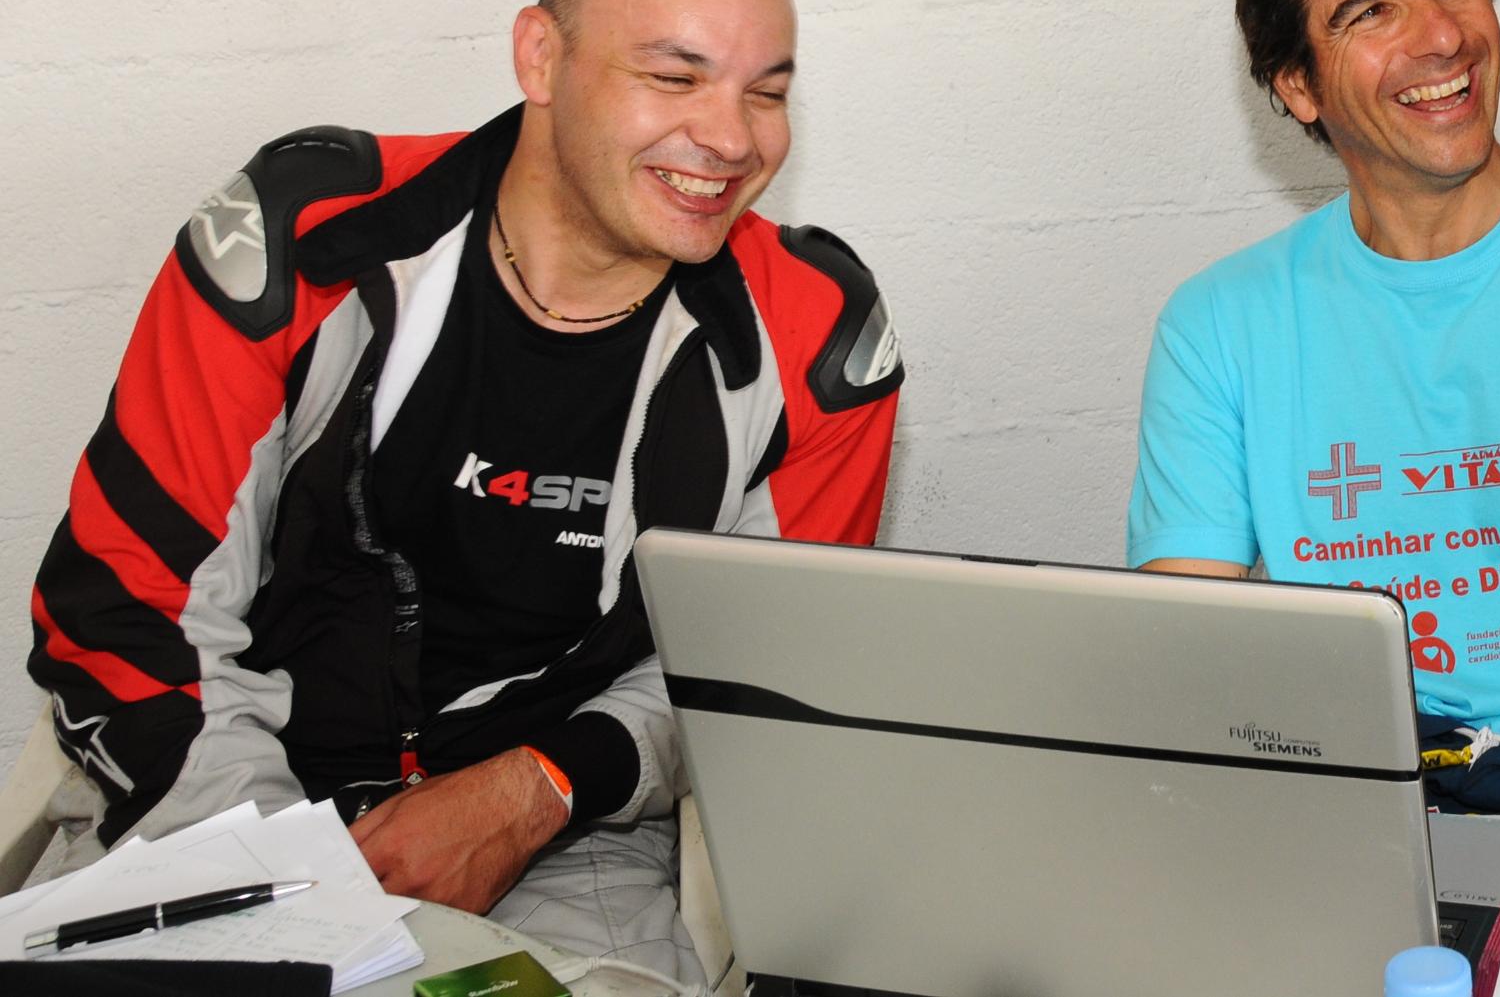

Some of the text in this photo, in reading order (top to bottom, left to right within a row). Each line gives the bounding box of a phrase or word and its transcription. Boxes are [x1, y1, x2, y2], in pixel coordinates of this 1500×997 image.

[1293, 530, 1436, 563] Caminhar
[1451, 574, 1470, 597] e
[1229, 722, 1282, 743] FUJITSU
[1253, 741, 1323, 757] SIEMENS
